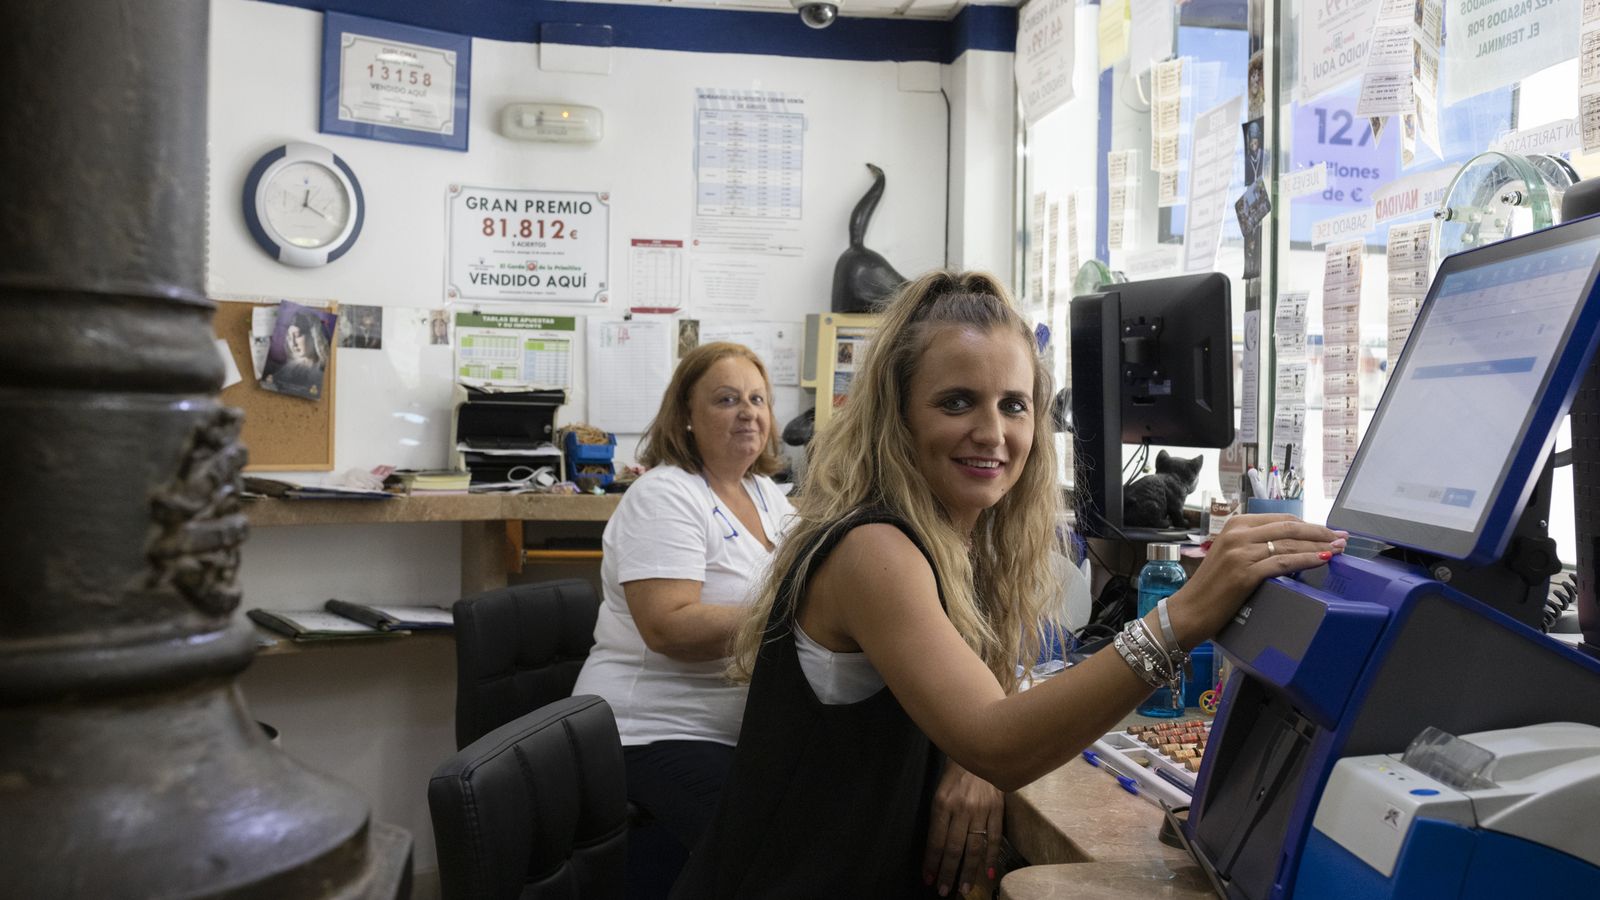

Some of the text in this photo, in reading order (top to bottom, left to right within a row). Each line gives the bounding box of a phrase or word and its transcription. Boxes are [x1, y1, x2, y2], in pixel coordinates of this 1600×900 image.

[367, 64, 432, 87] 13158
[369, 83, 428, 98] VENDIDO AQUÍ
[1322, 187, 1363, 202] de €
[465, 196, 592, 215] GRAN PREMIO
[482, 217, 578, 240] 81.812 €
[468, 272, 587, 289] VENDIDO AQUÍ
[482, 315, 508, 323] TABLAS
[520, 317, 555, 325] APUESTAS
